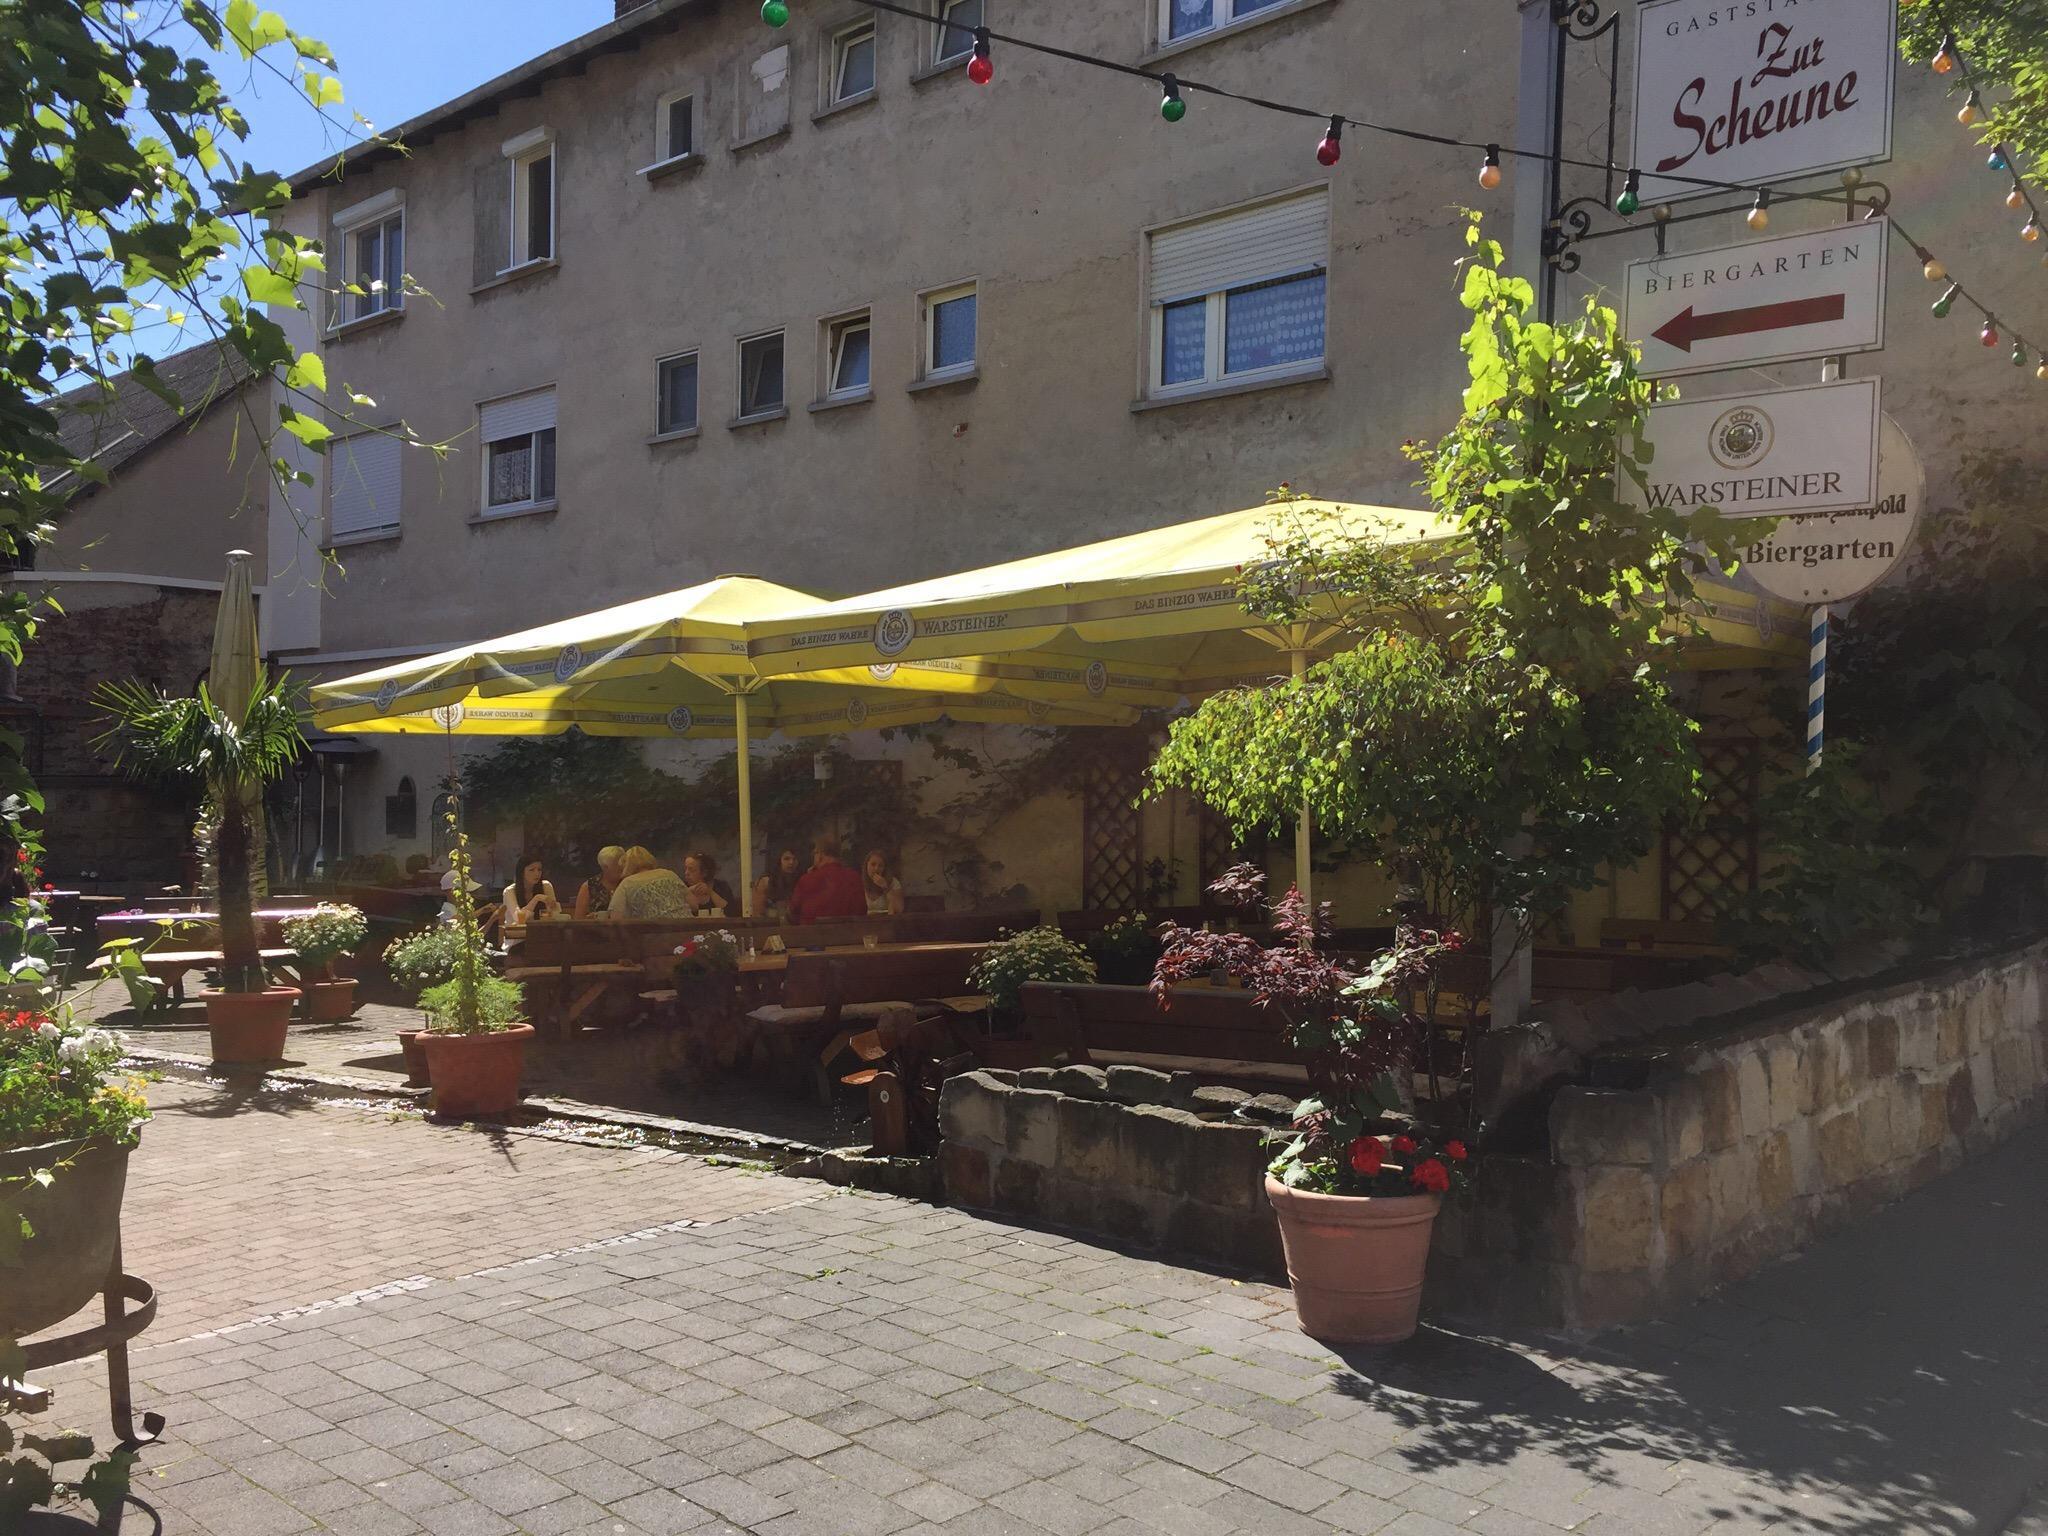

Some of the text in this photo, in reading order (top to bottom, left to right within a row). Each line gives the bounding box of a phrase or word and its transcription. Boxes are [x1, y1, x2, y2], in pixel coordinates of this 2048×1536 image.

[1751, 23, 1825, 88] Zur
[1656, 71, 1859, 172] Scheune
[1645, 245, 1859, 294] BIERGARTEN
[1645, 472, 1843, 509] WARSTEINER
[1746, 539, 1896, 567] Biergarten
[1134, 600, 1155, 611] DAS
[1157, 593, 1195, 608] EINZIG
[791, 629, 869, 647] DAS EINZIG WAHRE
[923, 613, 1007, 634] WARSTEINER
